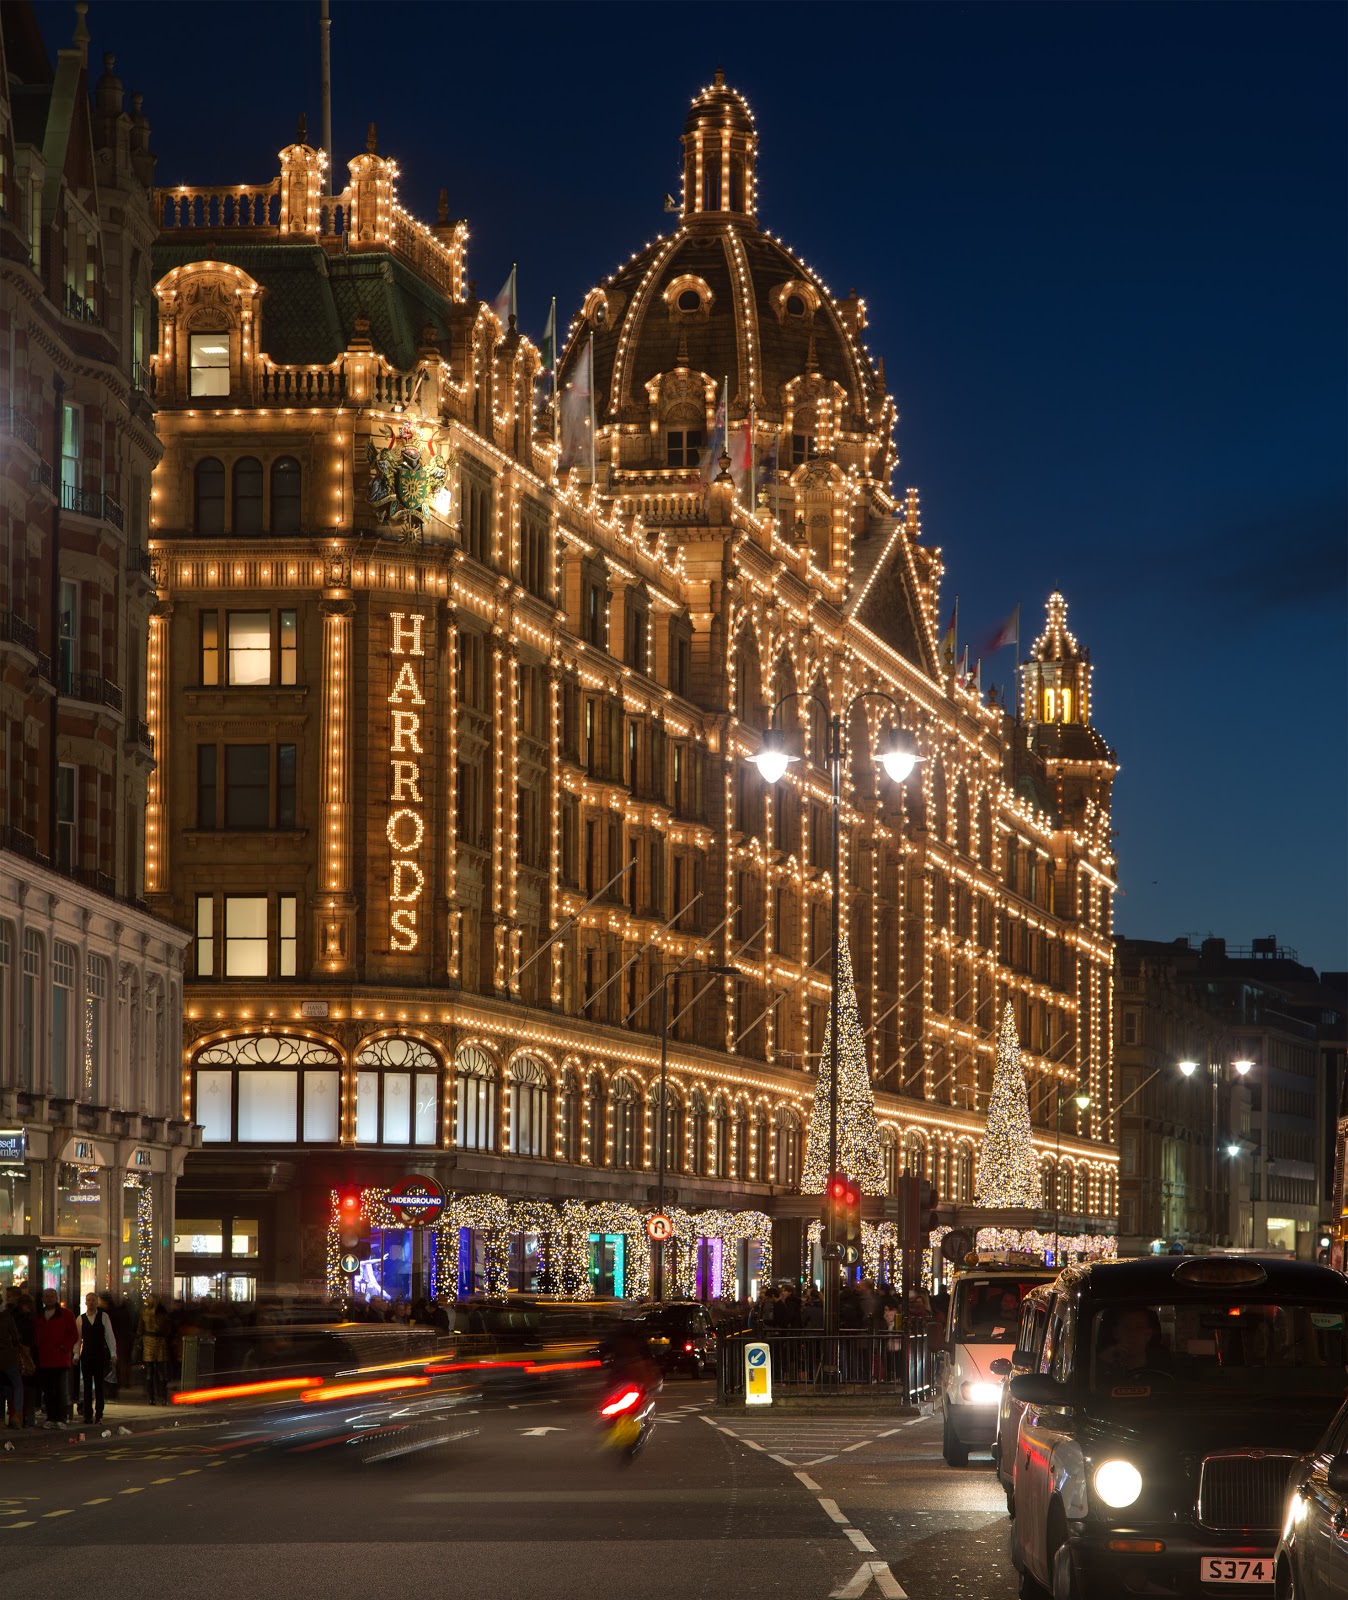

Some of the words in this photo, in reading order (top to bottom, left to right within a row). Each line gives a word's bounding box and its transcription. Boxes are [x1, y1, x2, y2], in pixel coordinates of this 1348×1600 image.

[386, 612, 426, 951] HARRODS
[0, 1148, 20, 1158] mley
[387, 1196, 442, 1205] UNDERGROUND
[1209, 1560, 1264, 1580] S374
